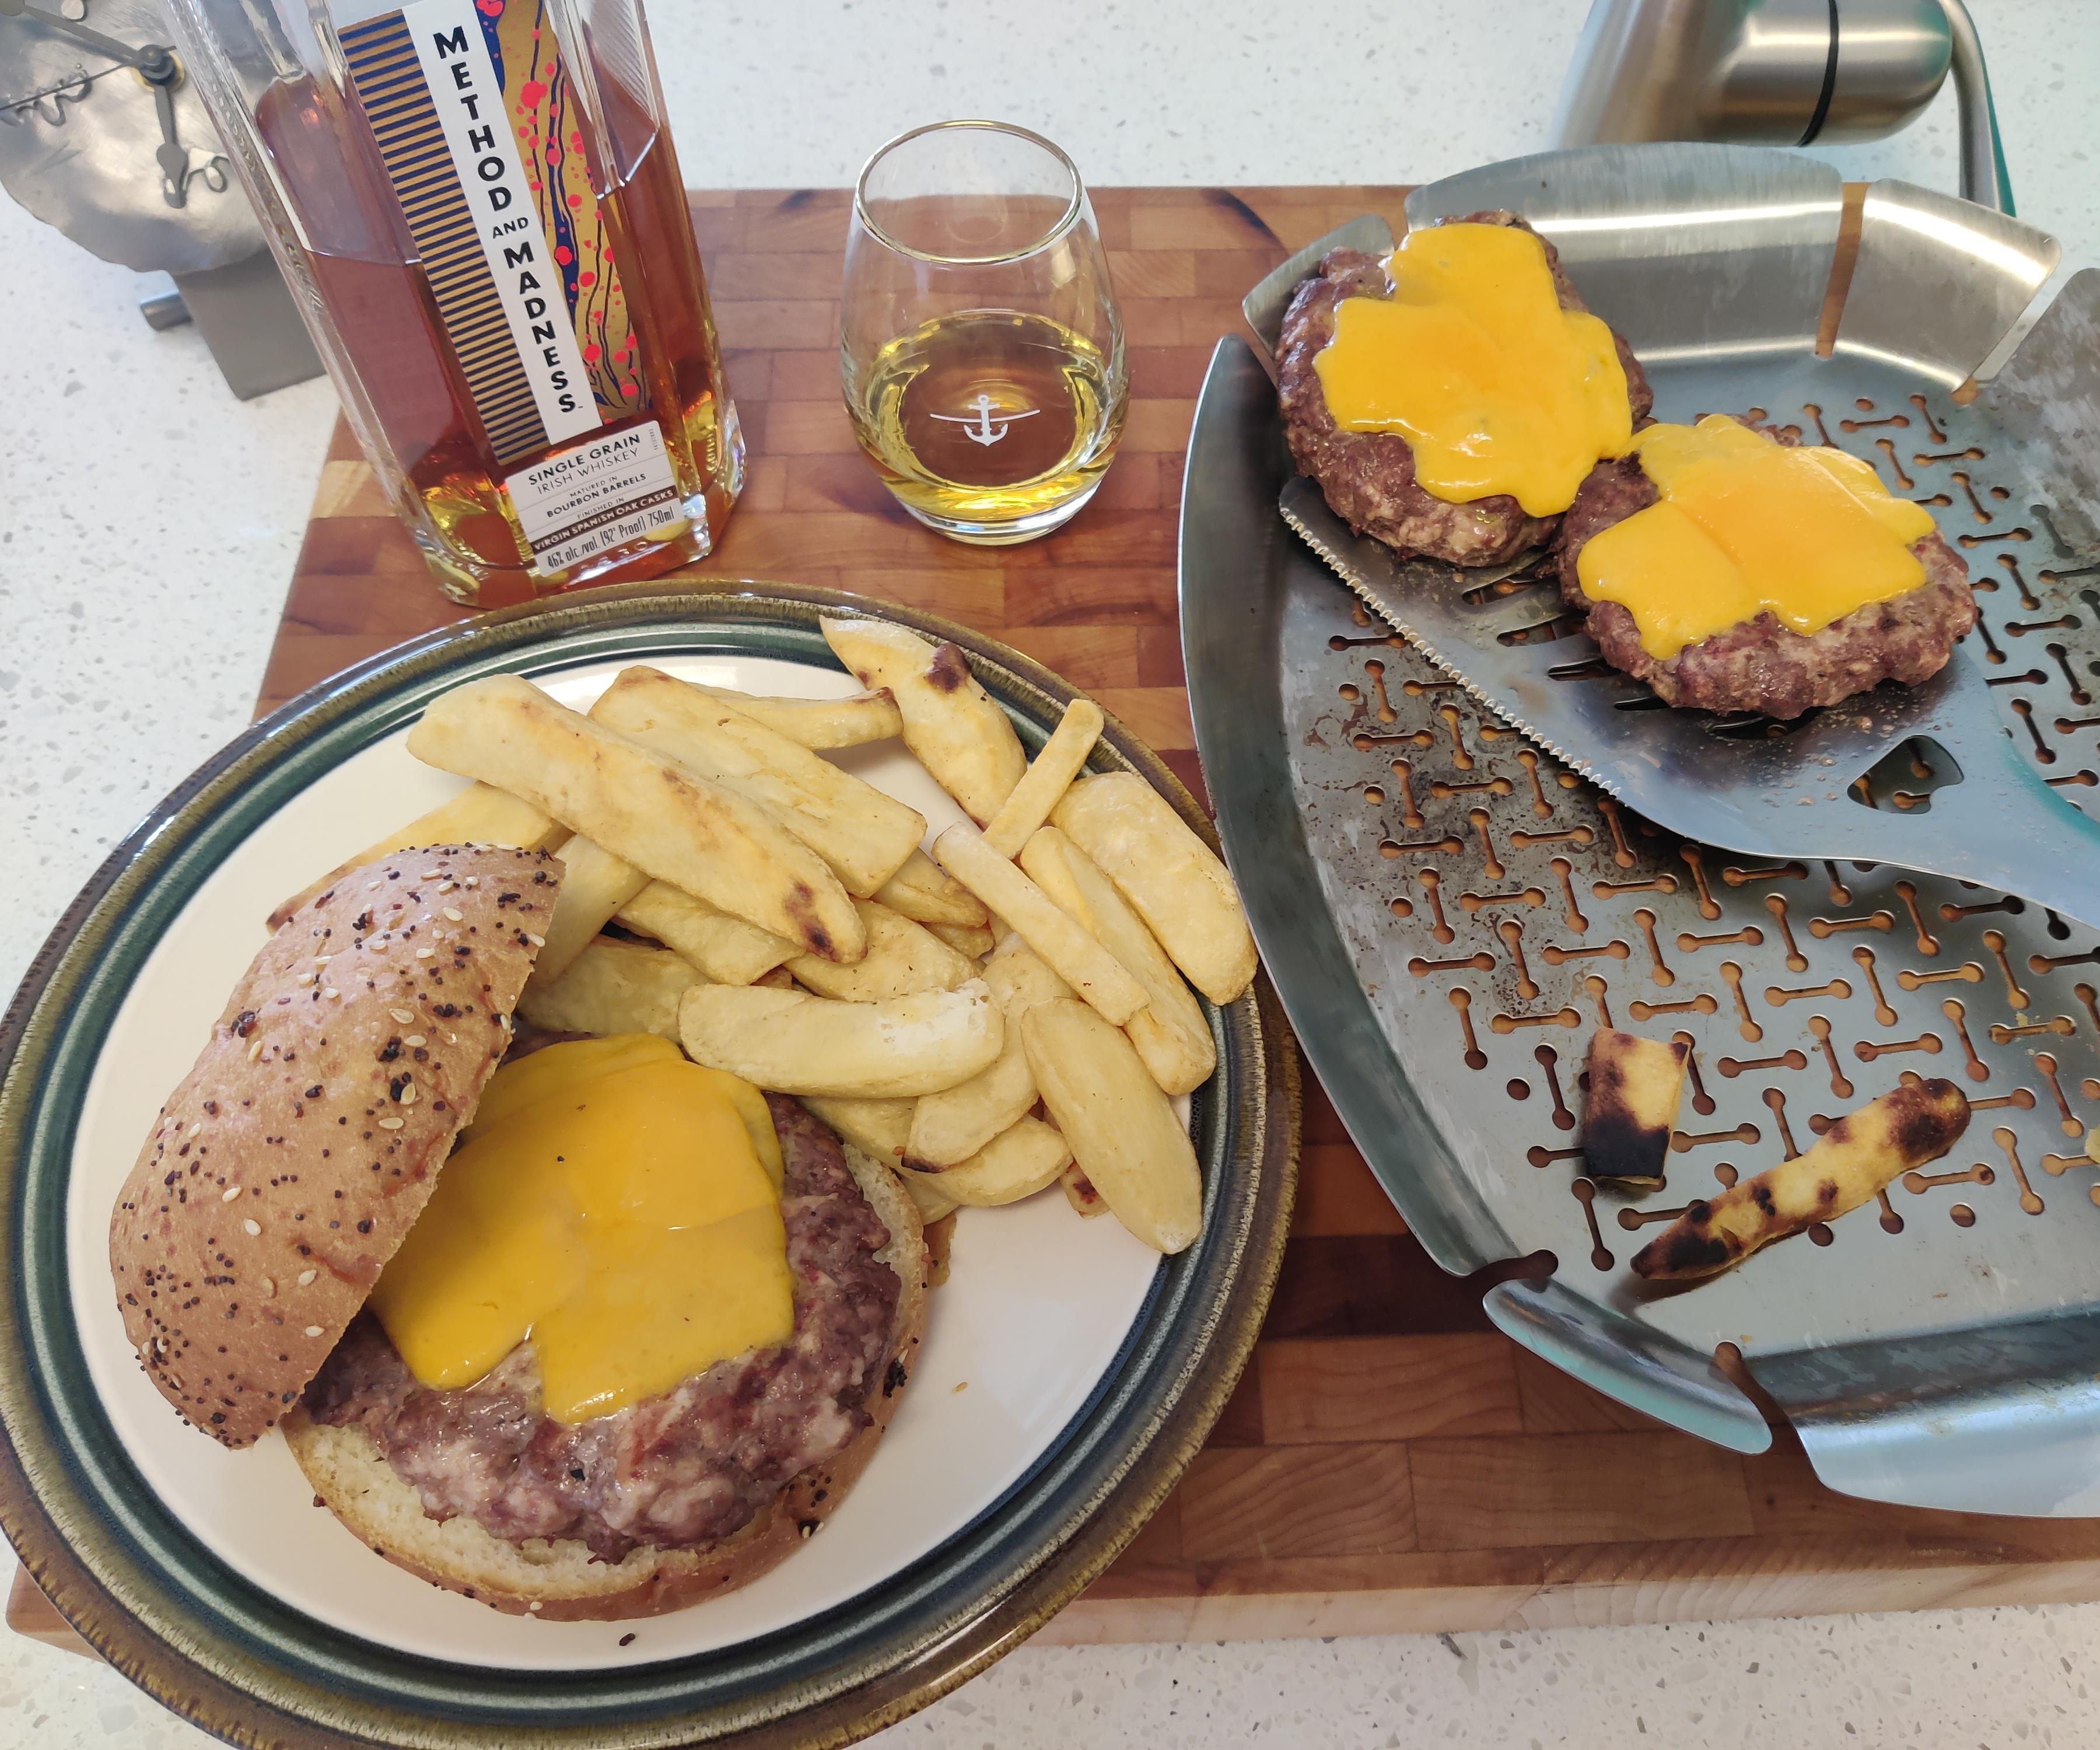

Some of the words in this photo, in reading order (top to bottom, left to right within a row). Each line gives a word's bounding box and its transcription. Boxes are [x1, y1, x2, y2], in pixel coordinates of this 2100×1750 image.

[433, 26, 512, 211] METHOD
[493, 217, 528, 239] AND
[503, 241, 576, 413] MADNESS
[528, 455, 585, 485] SINGLE
[589, 434, 640, 459] GRAIN
[537, 473, 573, 495] IRISH
[578, 447, 639, 478] WHISKEY
[547, 491, 600, 517] BOURBON
[603, 473, 646, 494] BARRELS
[570, 480, 606, 498] MATURED
[609, 475, 618, 484] IN
[578, 502, 612, 519] FINISHED
[534, 530, 570, 550] VIRGIN
[572, 511, 615, 534] SPANISH
[616, 502, 639, 516] OAK
[640, 489, 674, 507] CASKS
[547, 551, 565, 569] 46%
[649, 506, 675, 527] 750ml
